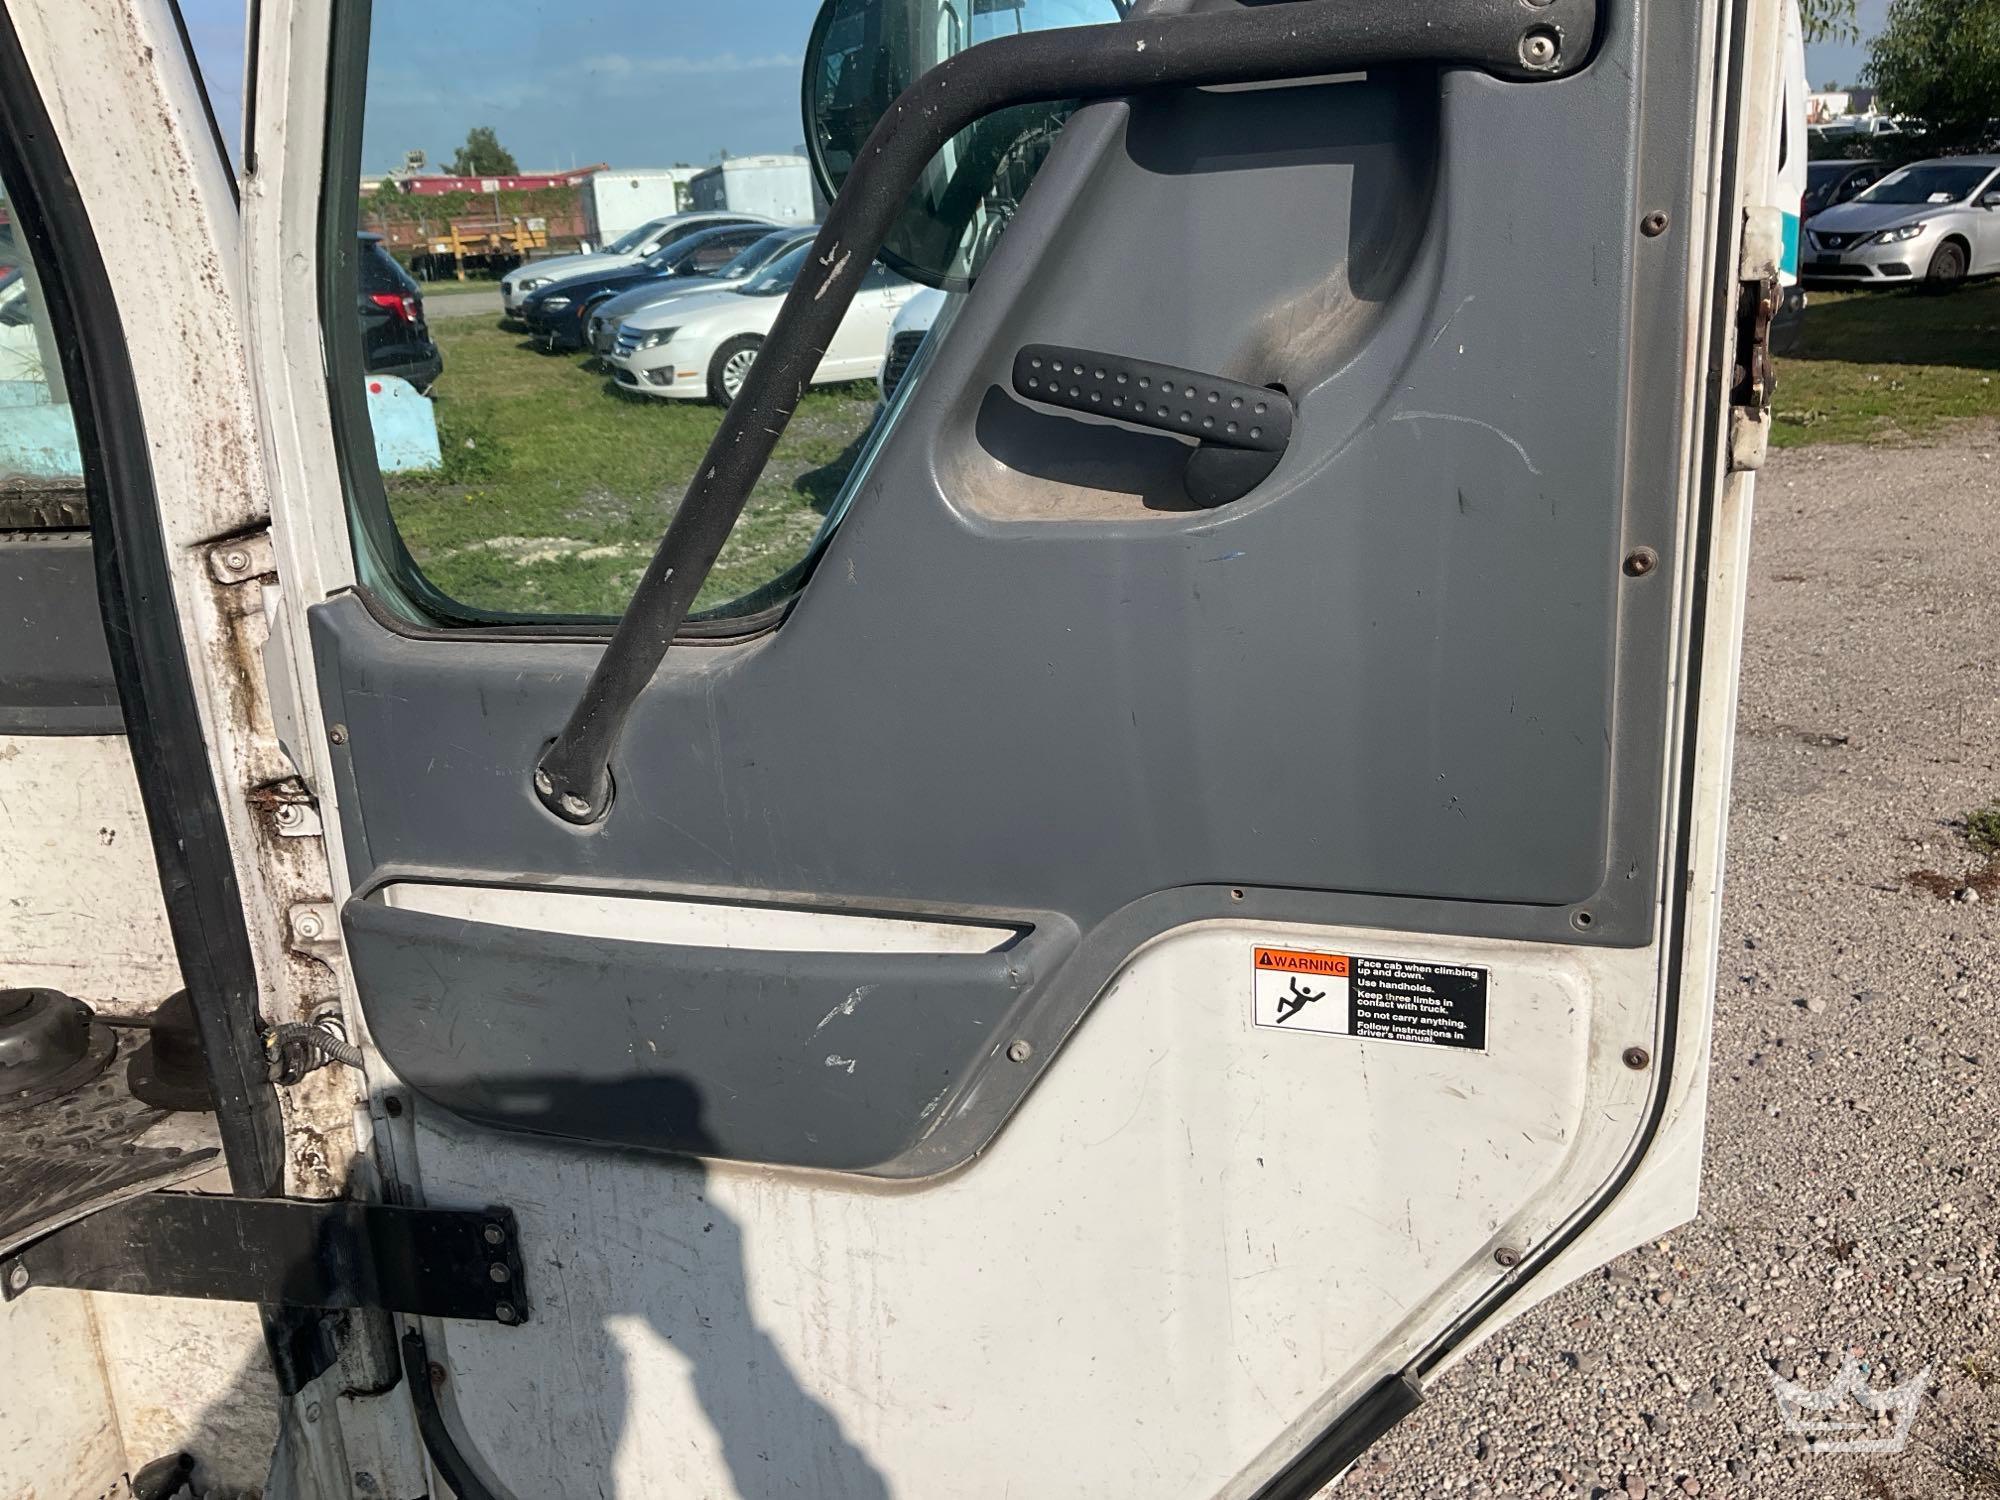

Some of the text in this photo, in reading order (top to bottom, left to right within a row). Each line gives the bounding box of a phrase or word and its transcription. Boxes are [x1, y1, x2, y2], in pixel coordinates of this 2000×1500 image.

[1273, 955, 1346, 973] WARNING
[1357, 959, 1478, 979] Face cab when climbing
[1357, 968, 1425, 980] up and down.
[1357, 978, 1436, 993] Use handholds.
[1357, 990, 1453, 1007] Keep three limbs in
[1357, 999, 1449, 1014] contact with truck.
[1357, 1009, 1467, 1029] Do not carry anything.
[1357, 1021, 1464, 1040] Follow instructions in
[1357, 1028, 1436, 1043] driver's manual.
